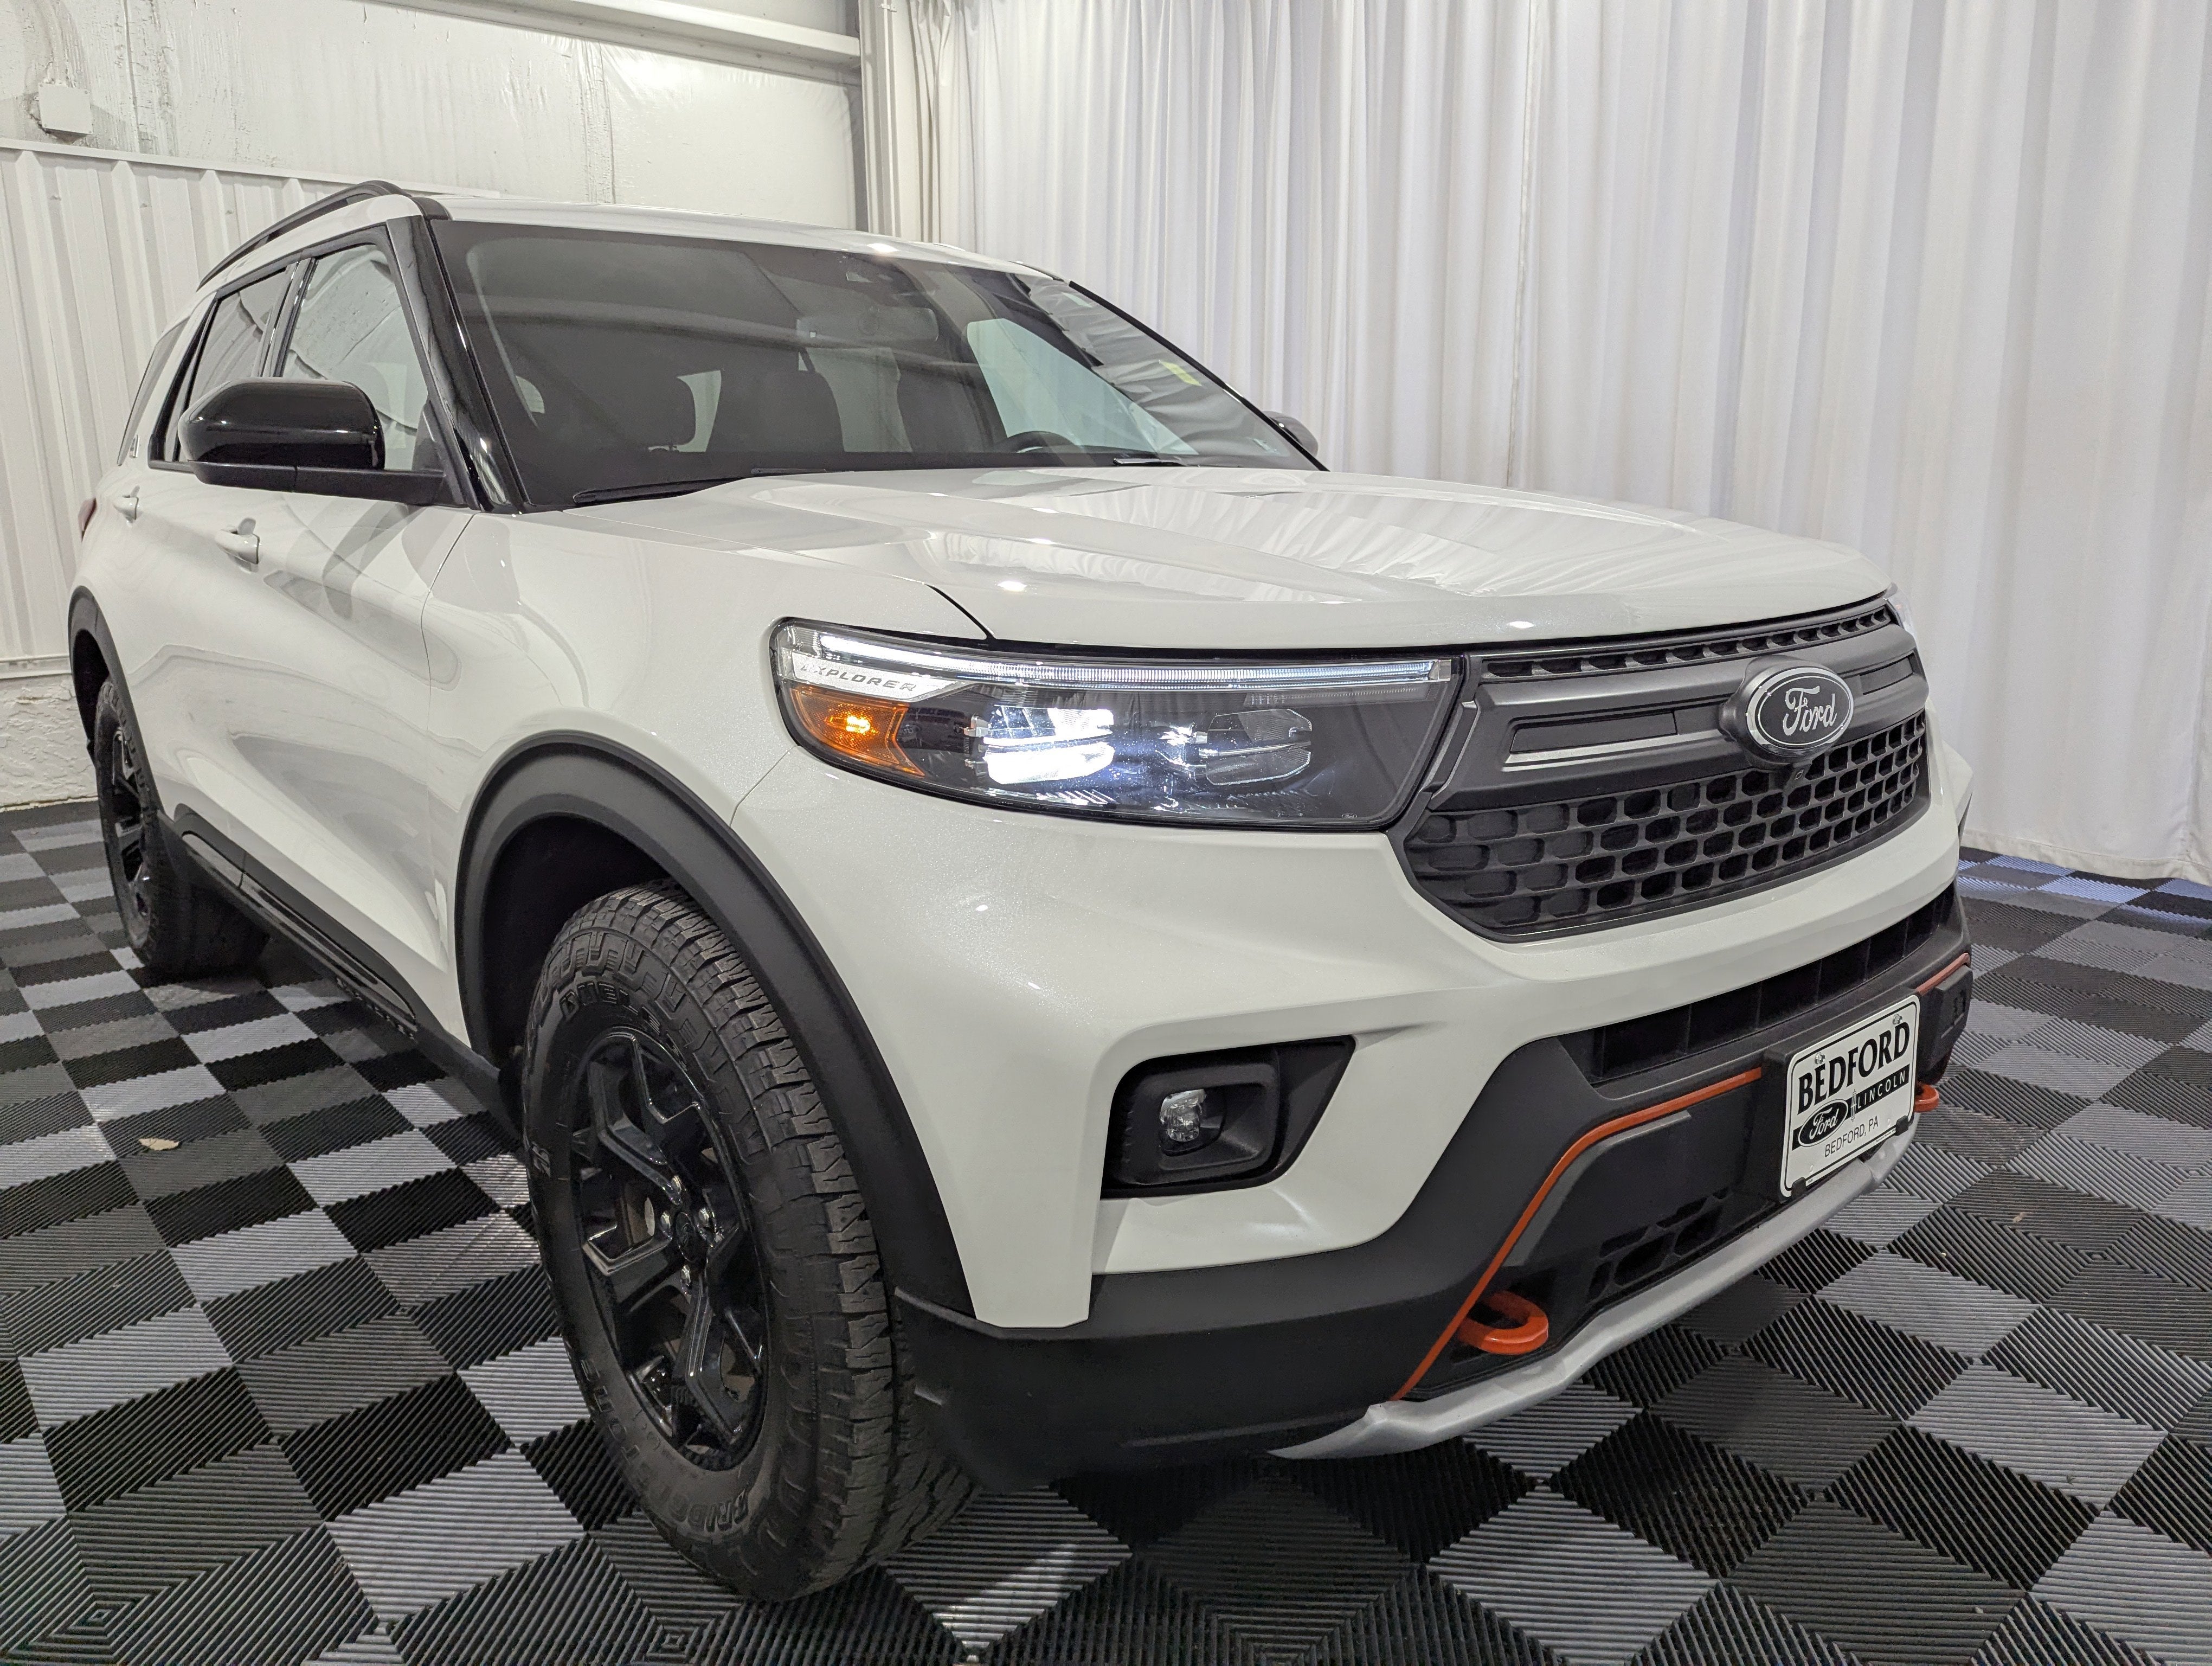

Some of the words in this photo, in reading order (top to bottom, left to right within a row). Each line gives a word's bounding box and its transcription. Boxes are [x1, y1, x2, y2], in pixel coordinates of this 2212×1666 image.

[800, 663, 916, 691] EXPLORER
[1783, 685, 1837, 736] Ford
[1797, 1022, 1910, 1115] BEDFORD
[1809, 1107, 1838, 1140] Ford
[1856, 1070, 1905, 1110] LINCOLN
[1824, 1125, 1867, 1158] BEDFORD,
[1868, 1115, 1879, 1132] PA
